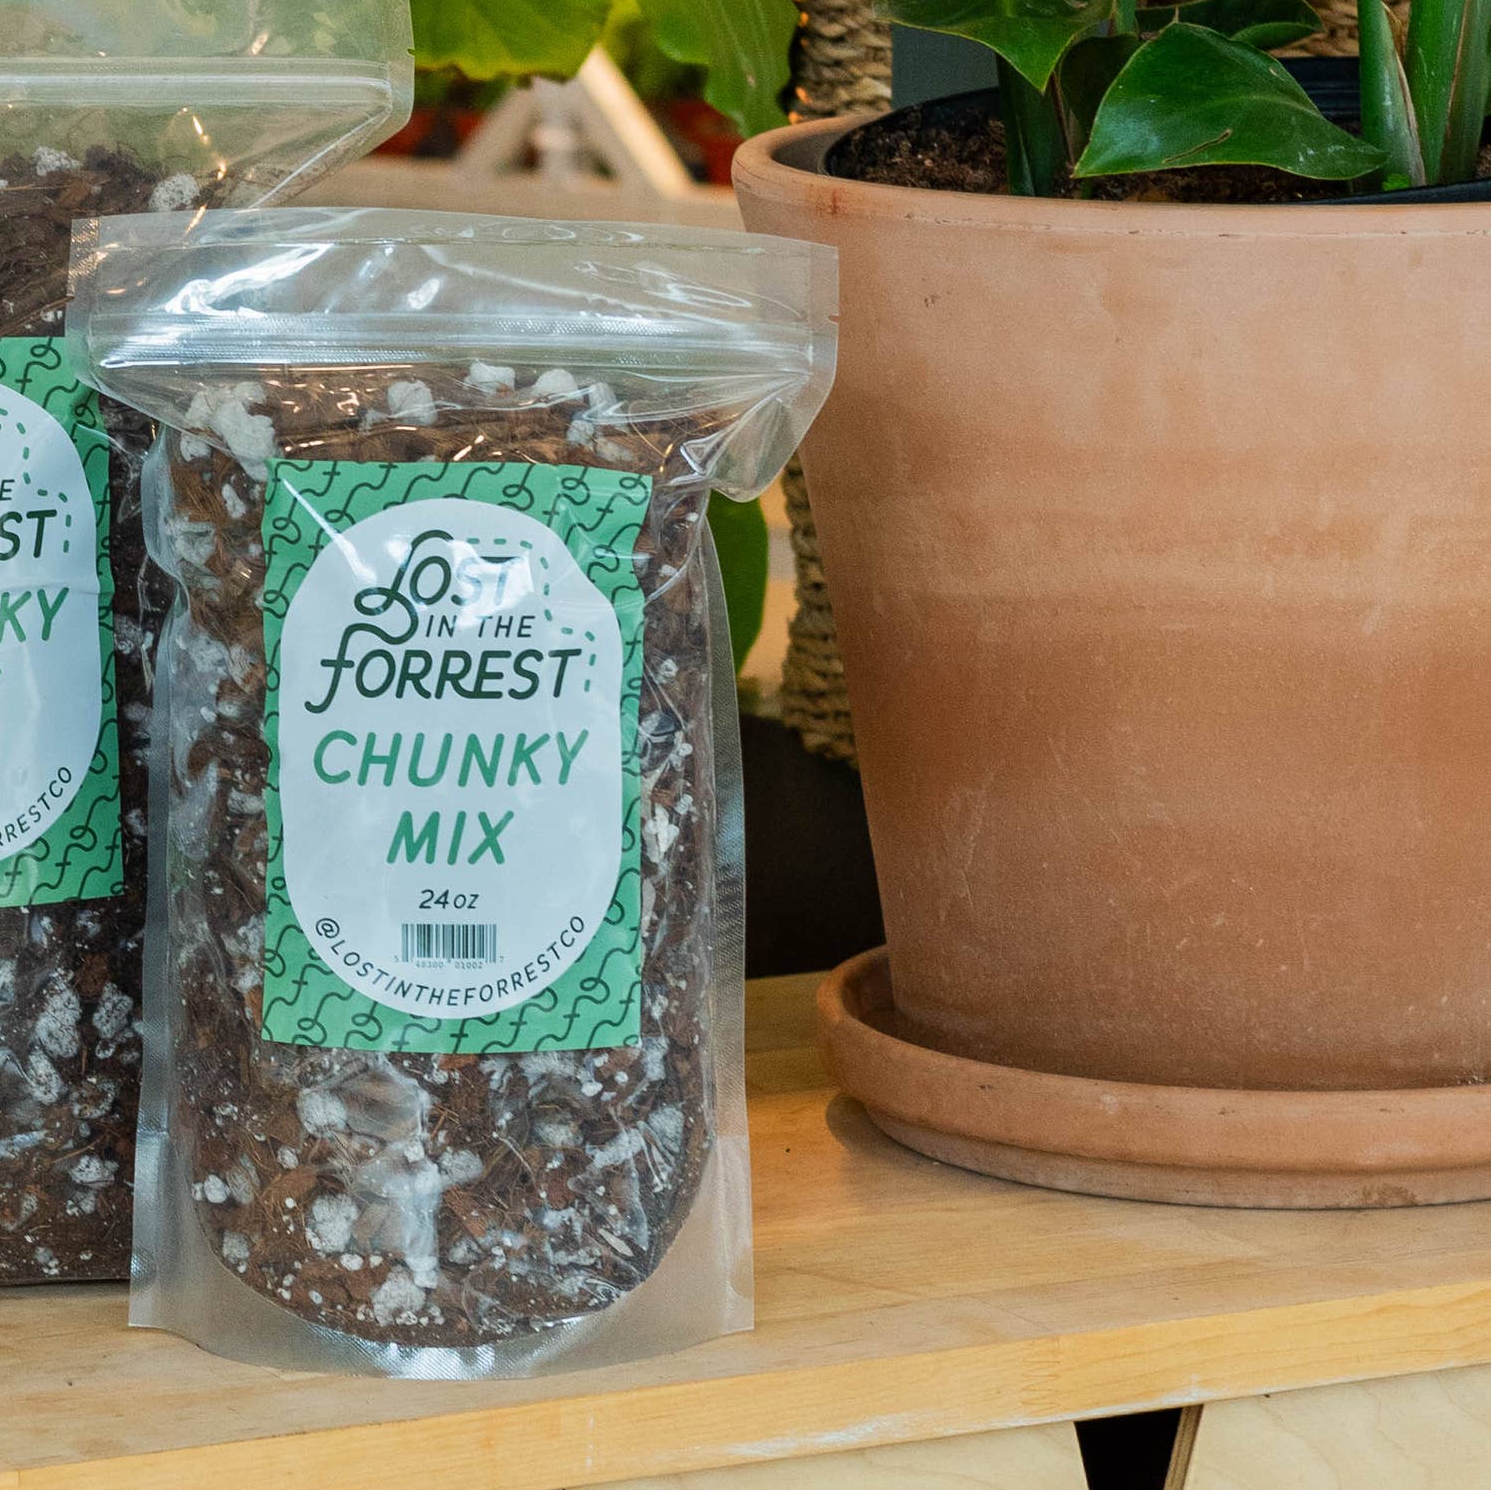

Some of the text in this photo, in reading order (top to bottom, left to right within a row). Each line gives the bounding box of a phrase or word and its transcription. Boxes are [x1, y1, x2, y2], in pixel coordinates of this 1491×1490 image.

[354, 529, 531, 643] LOST
[425, 614, 535, 639] IN THE
[313, 729, 589, 788] CHUNKY
[386, 811, 514, 866] MIX
[315, 914, 586, 1008] @LOSTINTHEFORRESTCO
